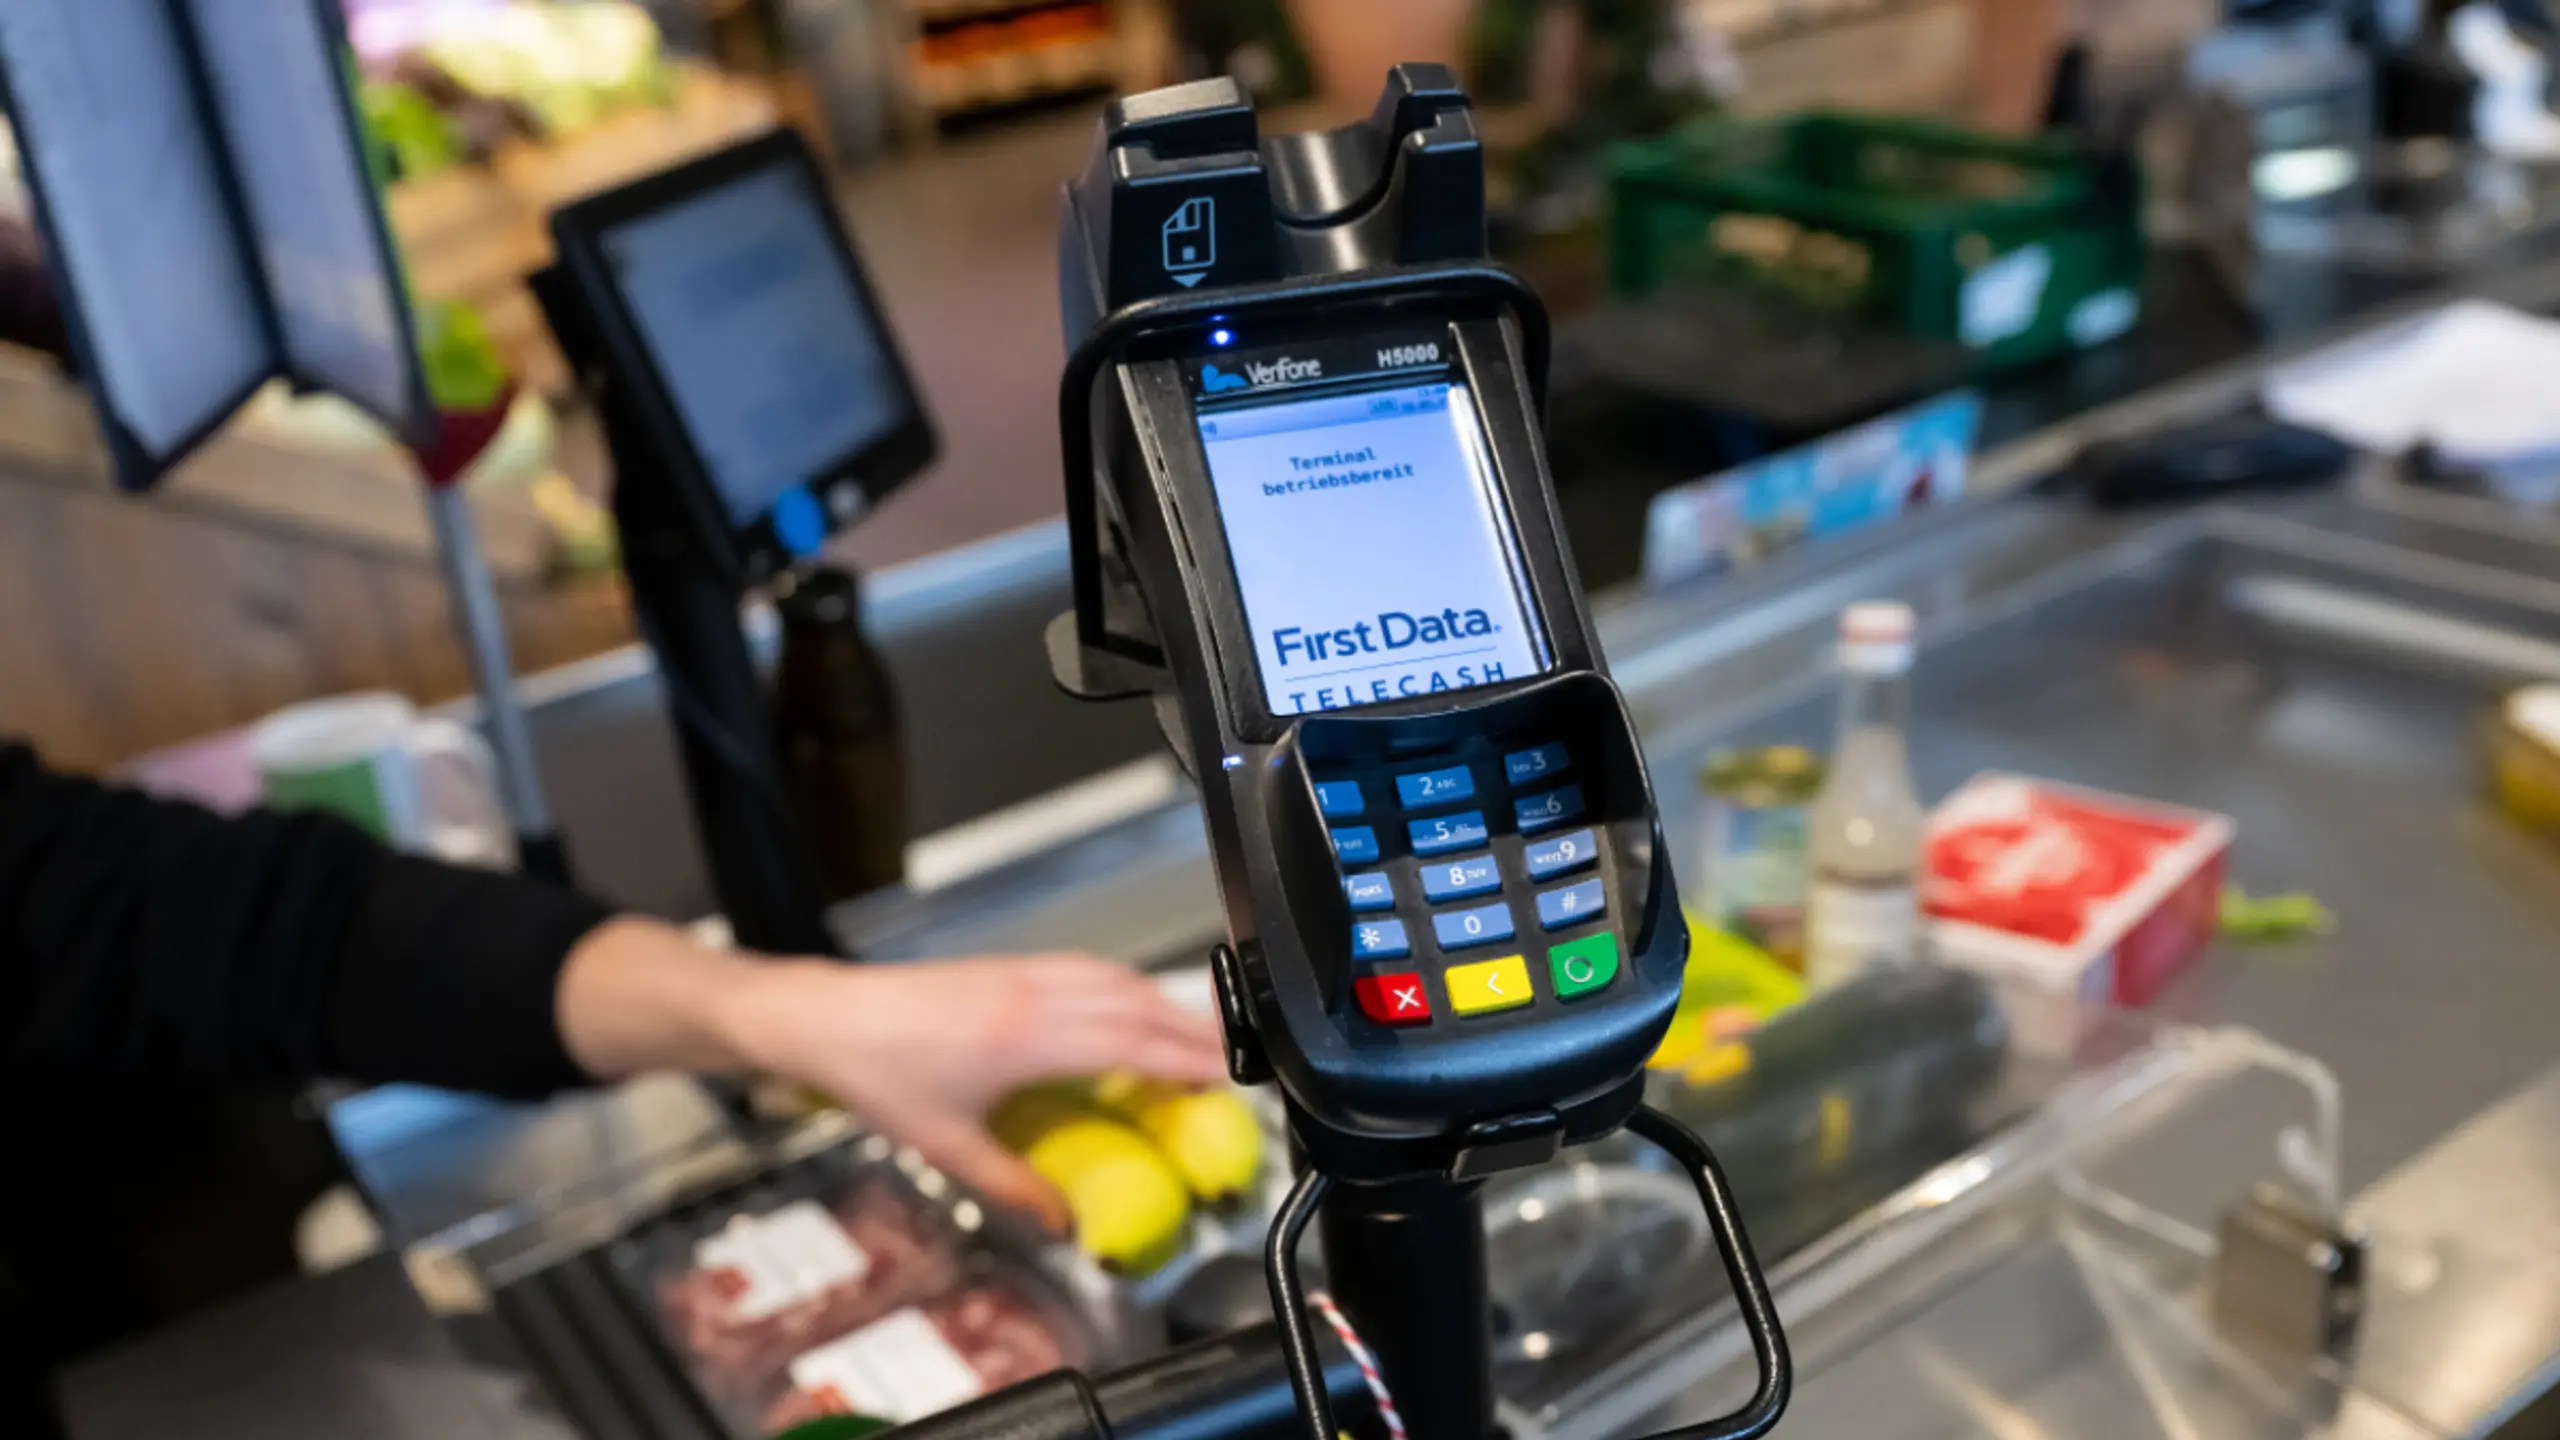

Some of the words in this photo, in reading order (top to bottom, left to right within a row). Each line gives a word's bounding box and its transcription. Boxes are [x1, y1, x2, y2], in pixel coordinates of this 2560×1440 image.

[1377, 344, 1439, 369] H5000
[1290, 447, 1376, 471] Terminal
[1262, 464, 1414, 496] betriebsbereit
[1272, 621, 1377, 666] First
[1288, 661, 1505, 712] TELECASH
[1531, 751, 1547, 771] 3
[1317, 787, 1329, 806] 1
[1418, 777, 1435, 796] 2
[1546, 794, 1562, 814] 6
[1435, 821, 1450, 841] 5
[1560, 840, 1577, 861] 9
[1449, 866, 1466, 886] 8
[1464, 914, 1482, 935] 0
